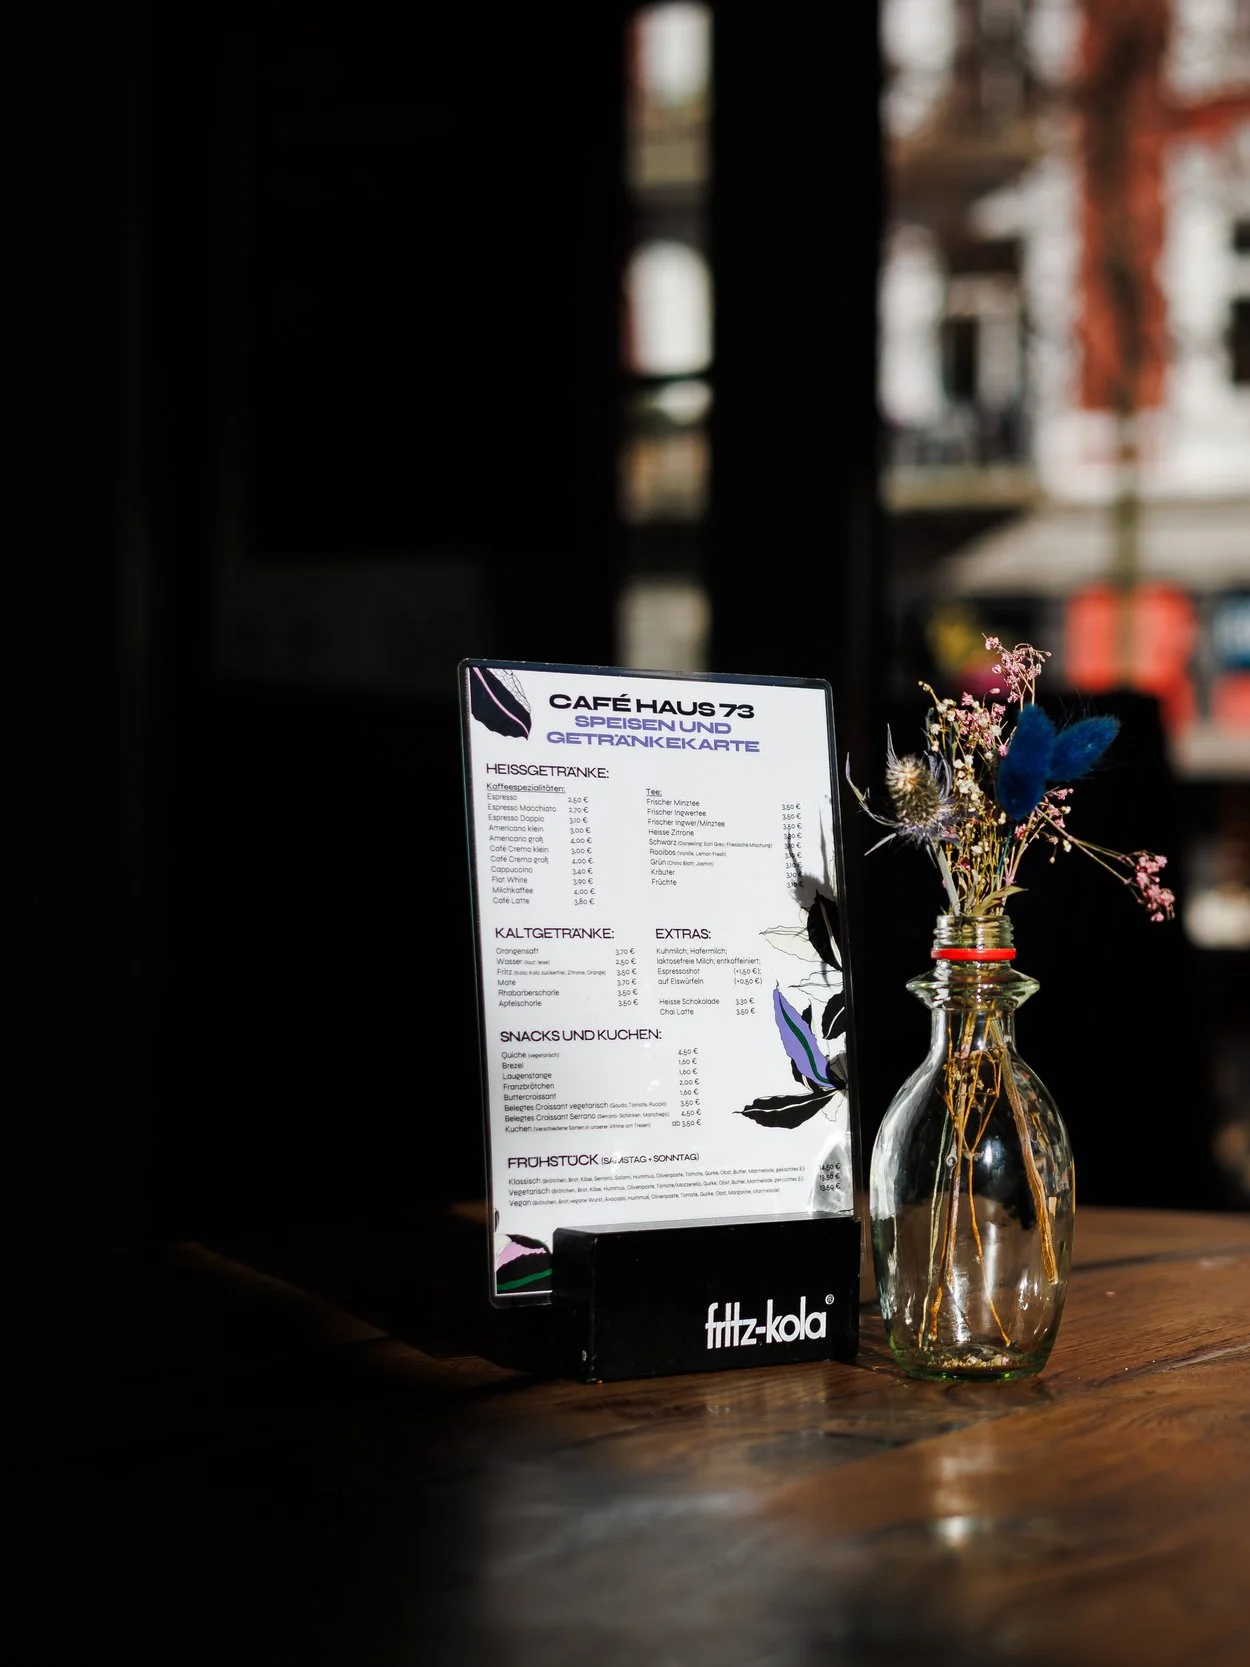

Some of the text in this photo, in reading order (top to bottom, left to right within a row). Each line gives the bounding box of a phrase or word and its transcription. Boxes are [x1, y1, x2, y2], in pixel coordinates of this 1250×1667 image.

[549, 693, 755, 719] CAFÉ HAUS 73
[574, 715, 732, 734] SPEISEN UND
[546, 731, 760, 753] GETRÄNKEKARTE
[486, 763, 609, 779] HEISSGETRÄNKE:
[486, 783, 565, 793] Kaffeespezialitäten:
[646, 788, 662, 797] Tee:
[675, 819, 725, 827] Ingwer/Minztee
[528, 836, 544, 844] groß
[650, 858, 666, 866] Grün
[491, 866, 533, 874] Cappuccino
[652, 878, 677, 886] Früchte
[495, 928, 615, 939] KALTGETRÄNKE:
[656, 928, 711, 939] EXTRAS:
[500, 1029, 662, 1043] SNACKS UND KUCHEN:
[503, 1072, 552, 1080] Laugenstange
[503, 1082, 554, 1090] Franzbrötchen
[504, 1093, 556, 1101] Buttercroissant
[504, 1104, 534, 1112] Belegtes
[569, 1102, 609, 1110] vegetarisch
[505, 1114, 535, 1122] Belegtes
[508, 1154, 598, 1168] FRÜHSTÜCK
[653, 1153, 699, 1162] SONNTAG)
[509, 1188, 550, 1196] Vegetarisch
[705, 1296, 827, 1349] fritz-kola
